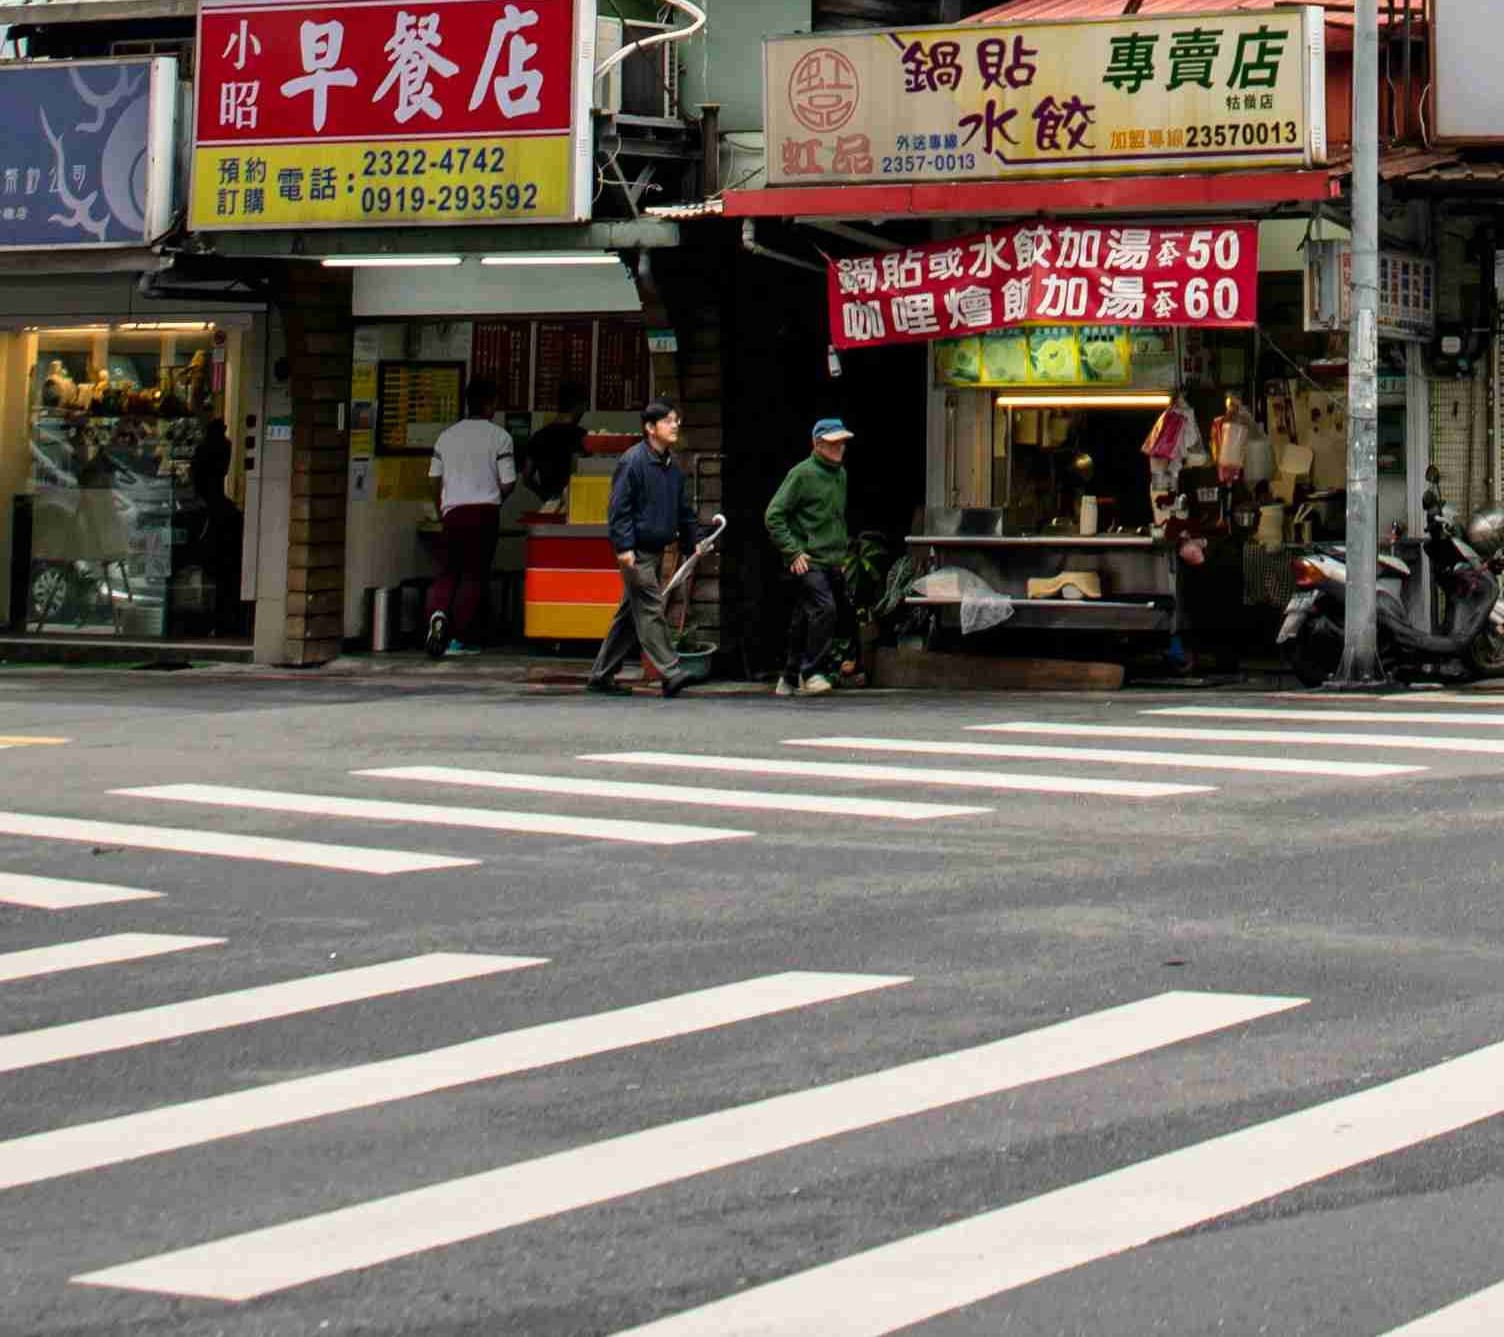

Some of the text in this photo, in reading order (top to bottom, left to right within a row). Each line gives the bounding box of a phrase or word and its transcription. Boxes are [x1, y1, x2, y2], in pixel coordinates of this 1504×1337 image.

[219, 20, 262, 129] 小昭
[280, 4, 545, 133] 早餐店
[901, 33, 1040, 95] 鍋貼
[1102, 23, 1290, 95] 專賣店
[1224, 93, 1276, 111] 牯嶺店
[958, 94, 1098, 155] 水餃
[1109, 120, 1299, 150] 加盟專線 23570013
[782, 133, 875, 176] 虹品
[895, 132, 959, 153] 外送專線
[217, 157, 267, 186] 預約
[362, 146, 506, 177] 2322-4742
[881, 151, 977, 175] 2357-0013
[216, 188, 265, 215] 訂購
[361, 183, 538, 214] 0919-293592
